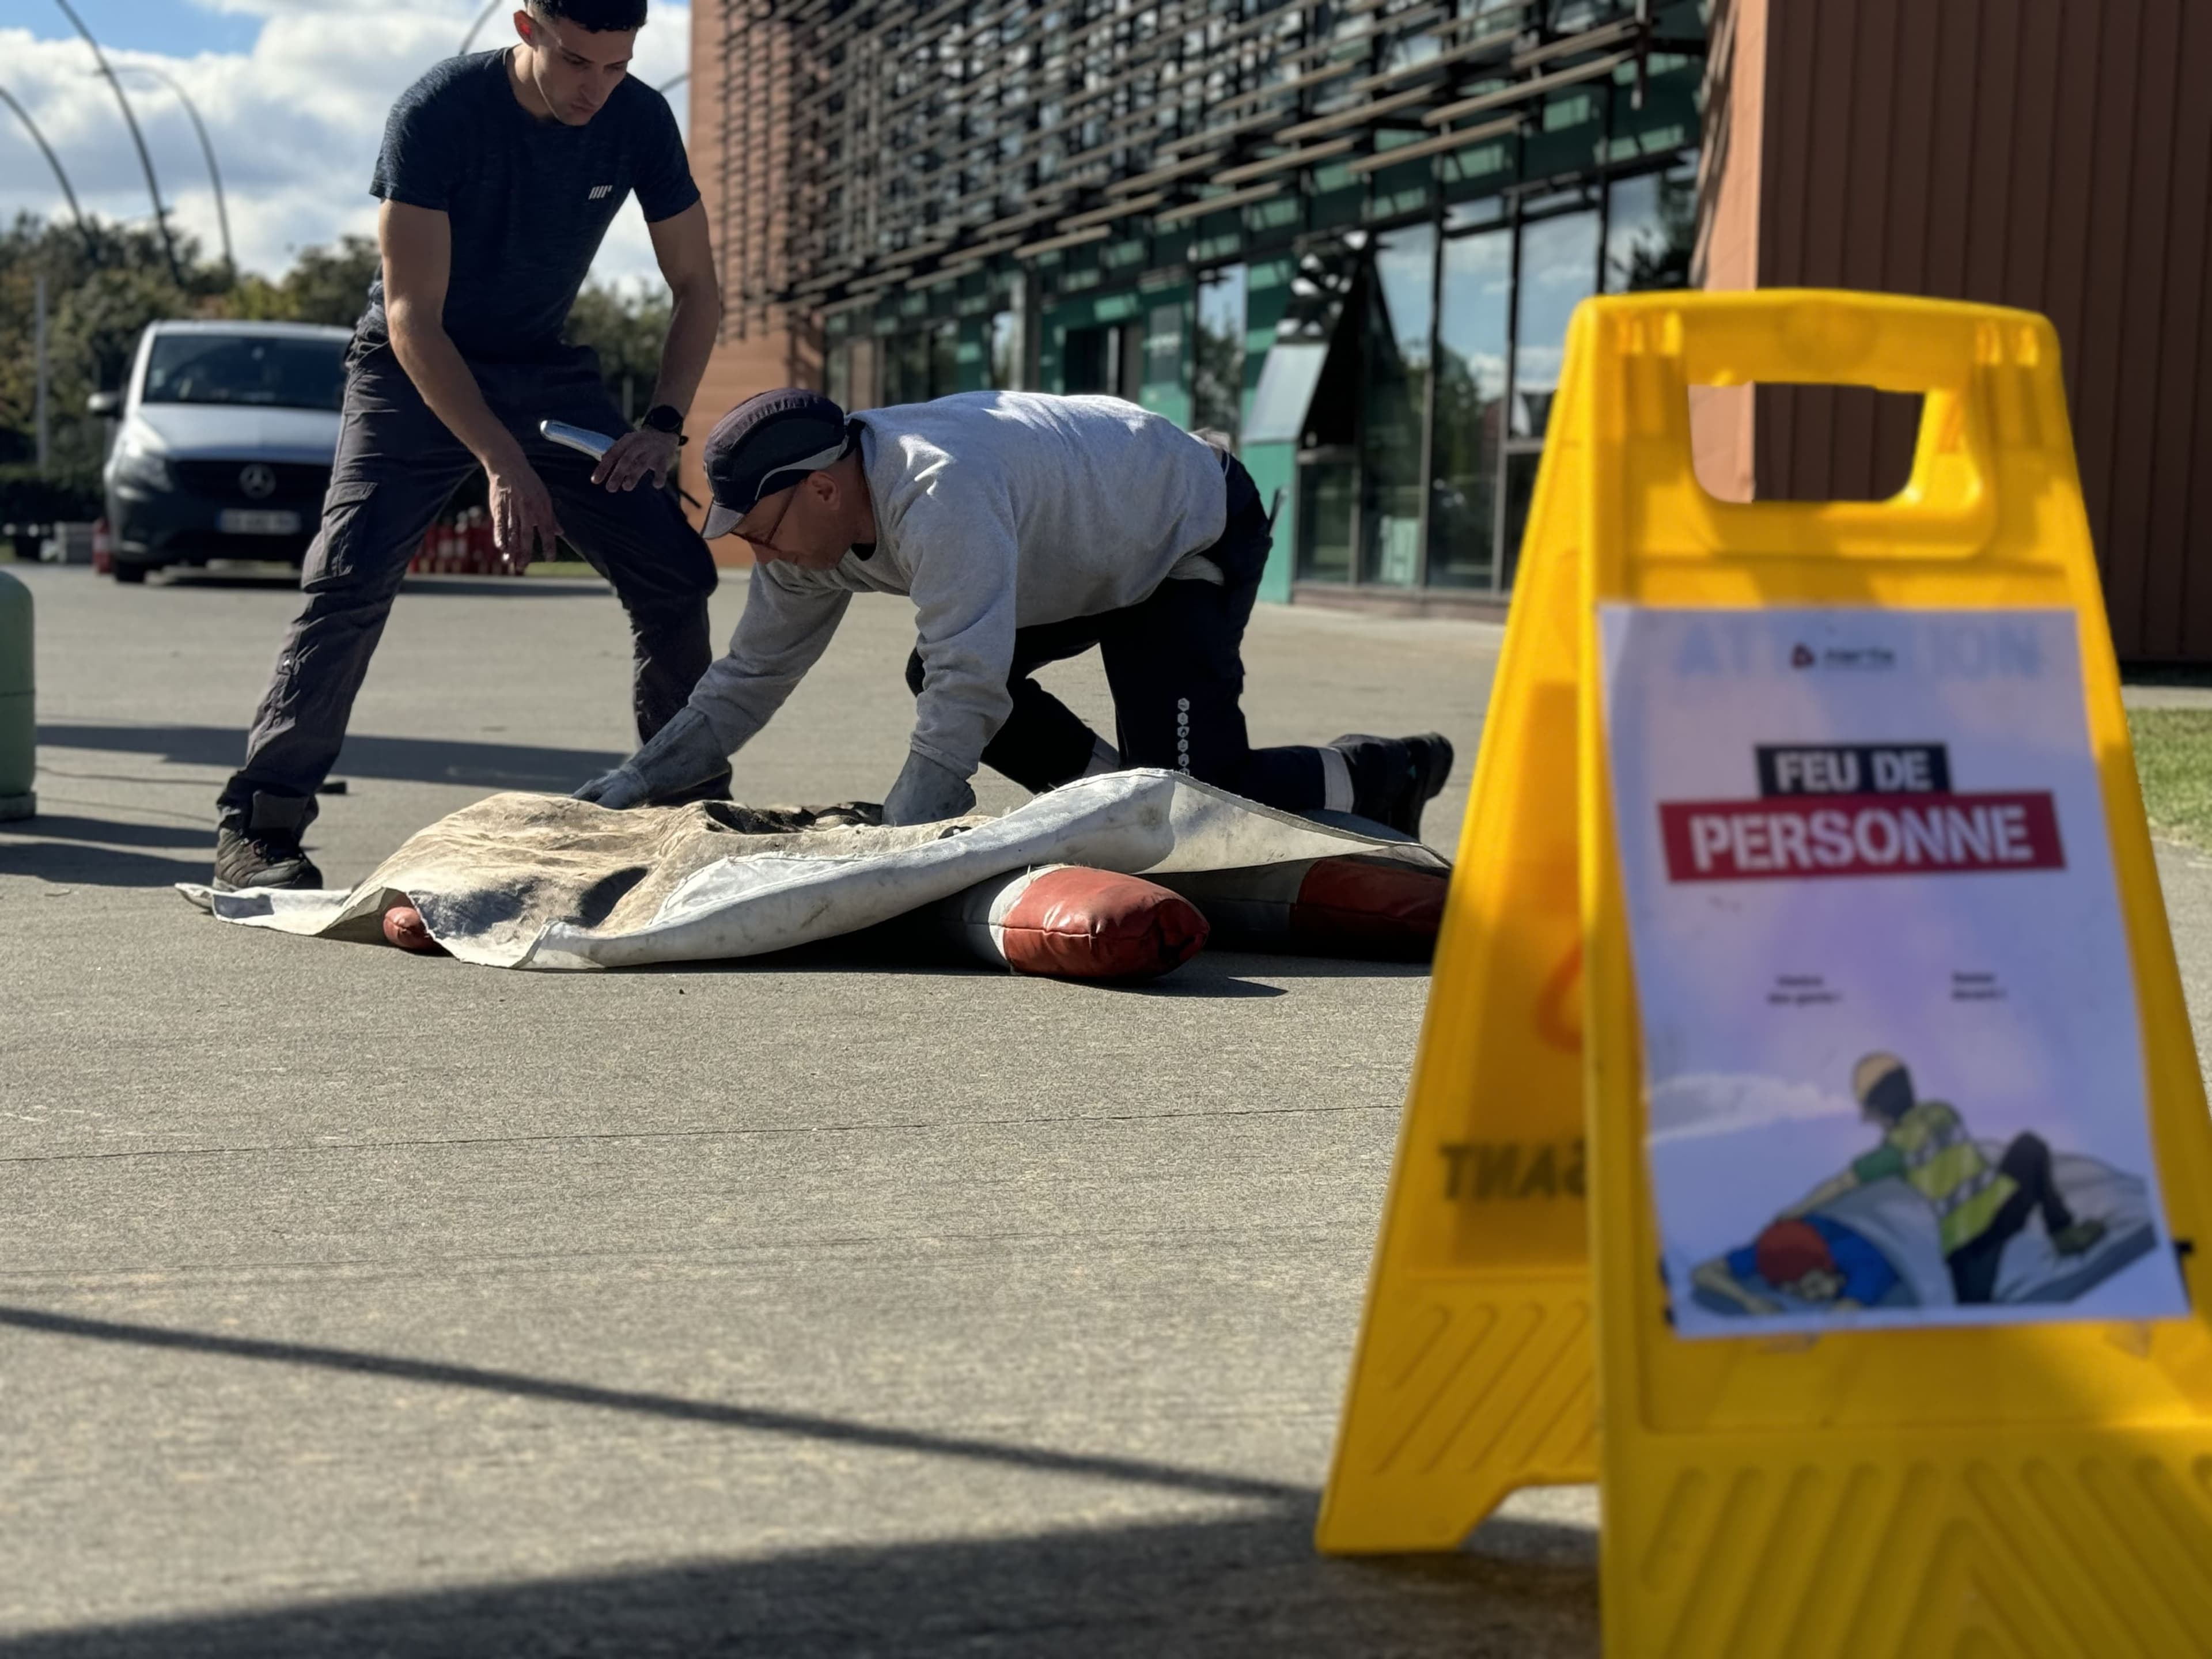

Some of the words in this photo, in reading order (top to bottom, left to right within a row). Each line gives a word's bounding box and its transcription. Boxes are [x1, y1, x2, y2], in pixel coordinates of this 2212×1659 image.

[1775, 750, 1860, 792] FEU
[1872, 750, 1933, 791] DE
[1689, 805, 2033, 871] PERSONNE
